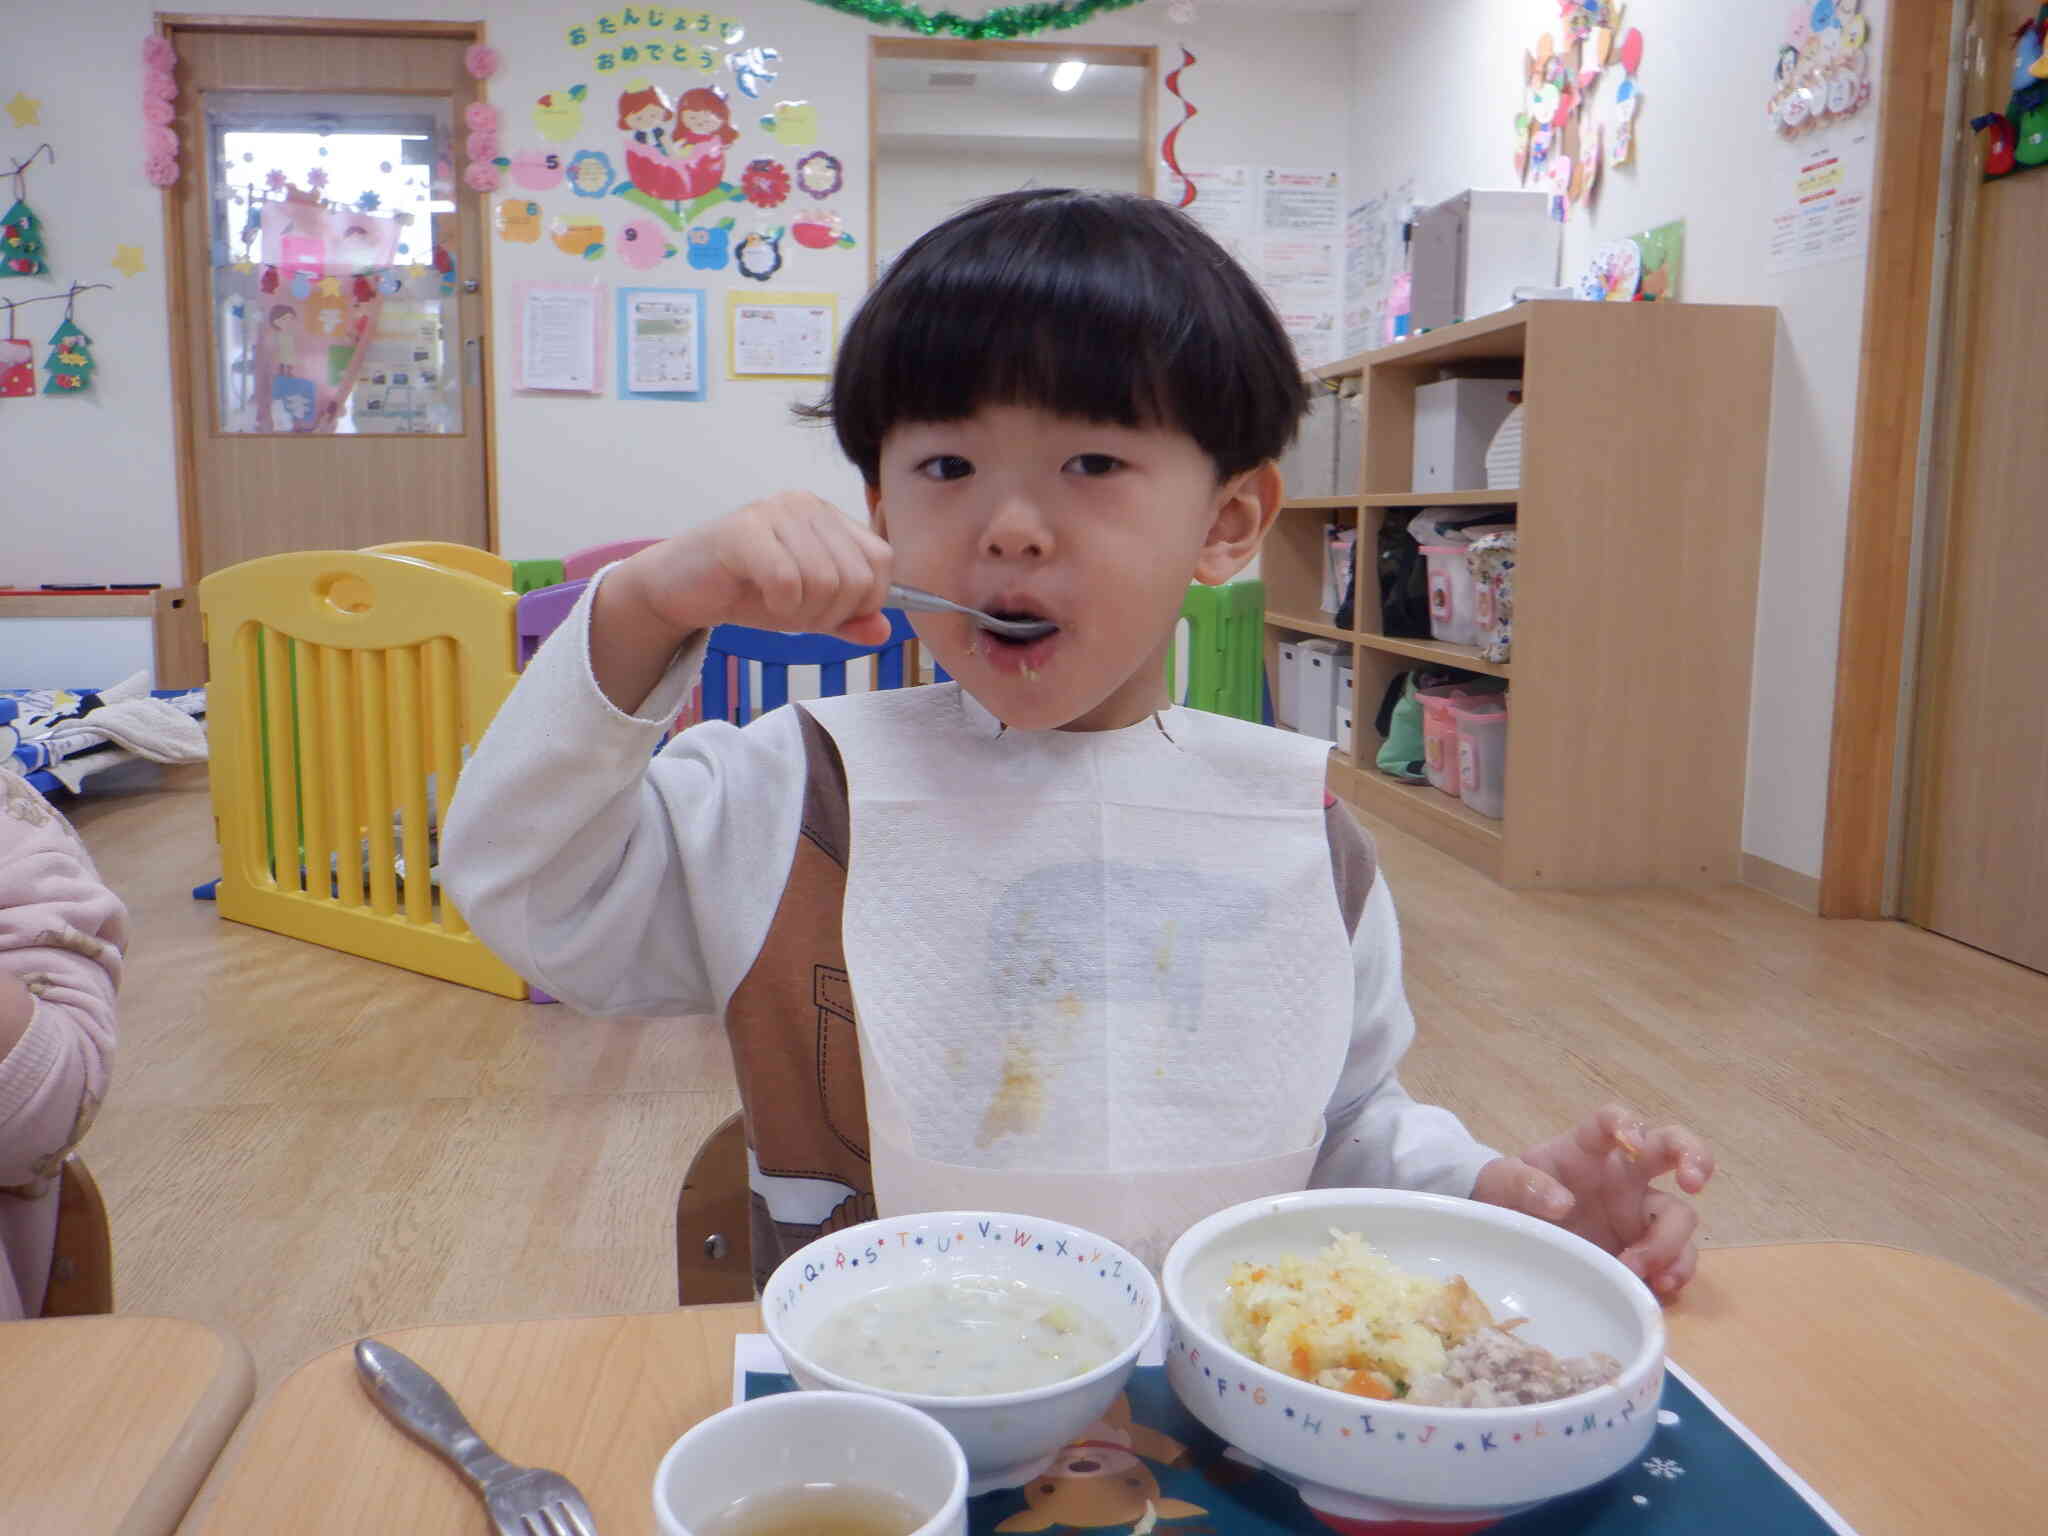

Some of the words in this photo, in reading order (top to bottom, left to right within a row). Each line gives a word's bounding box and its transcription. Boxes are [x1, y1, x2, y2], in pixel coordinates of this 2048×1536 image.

[597, 44, 713, 71] おめでとう
[545, 154, 559, 170] 5
[804, 1263, 819, 1282] Q
[864, 1247, 878, 1264] S
[895, 1231, 911, 1248] T
[937, 1235, 951, 1253] U
[978, 1220, 991, 1238] V
[1013, 1227, 1032, 1248] W
[1055, 1239, 1069, 1257] X
[1111, 1260, 1122, 1278] Z
[1216, 1377, 1227, 1398] F
[1302, 1413, 1322, 1435] H
[1359, 1414, 1375, 1434] I
[1418, 1424, 1437, 1445] J
[1480, 1431, 1497, 1452] K
